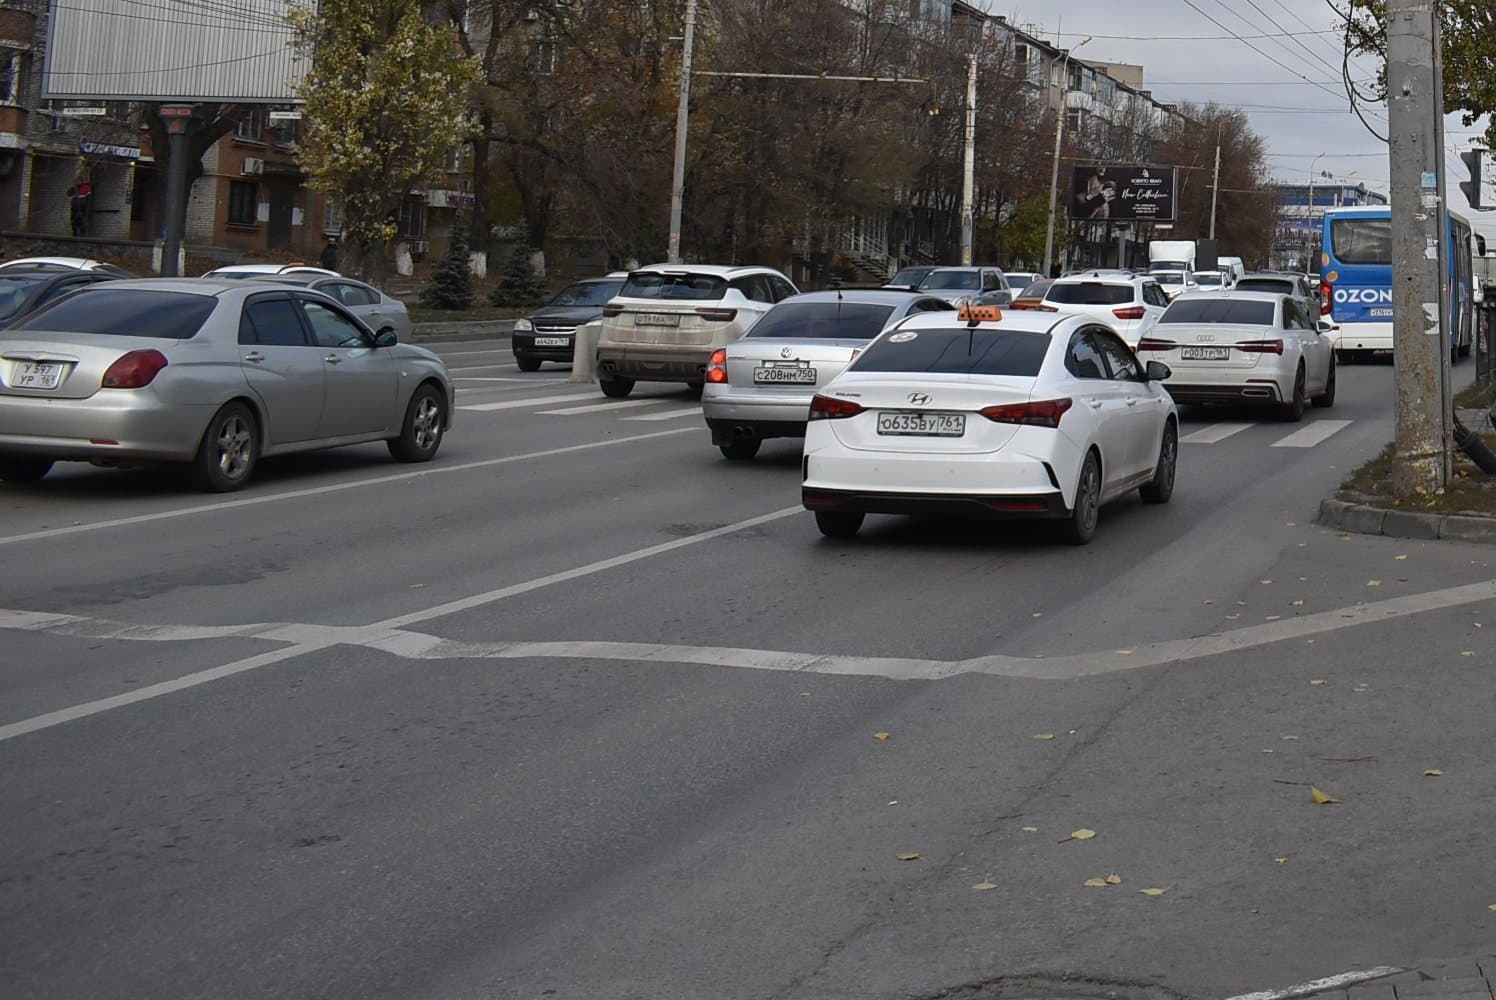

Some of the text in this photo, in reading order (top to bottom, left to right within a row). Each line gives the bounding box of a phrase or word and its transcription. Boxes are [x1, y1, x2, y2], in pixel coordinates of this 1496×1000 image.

[1334, 289, 1393, 303] OZON
[757, 370, 813, 380] С208НМ 750
[882, 416, 960, 431] О635ВУ 761
